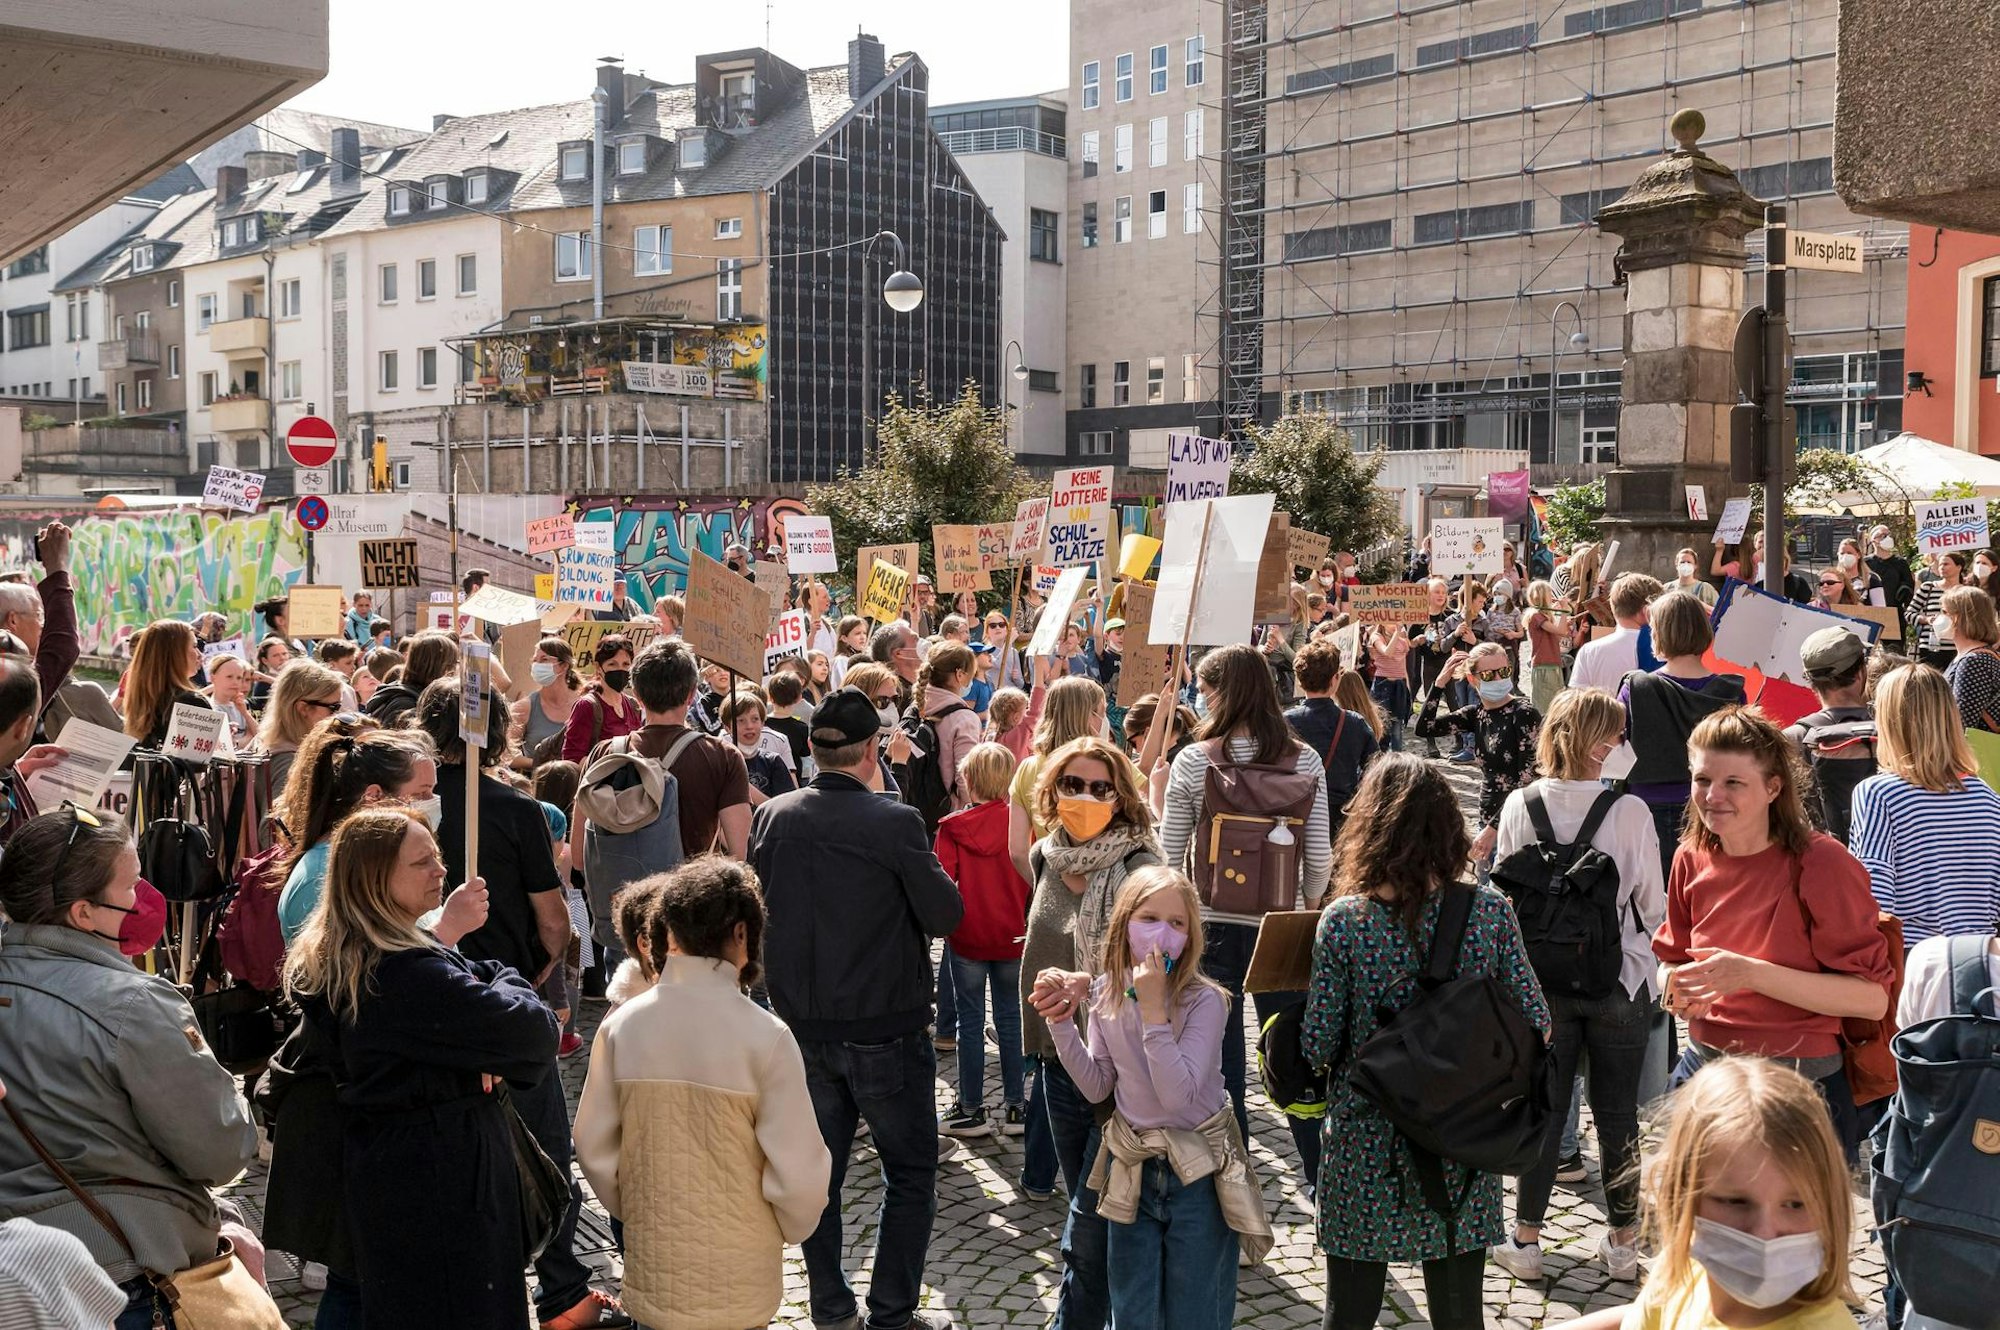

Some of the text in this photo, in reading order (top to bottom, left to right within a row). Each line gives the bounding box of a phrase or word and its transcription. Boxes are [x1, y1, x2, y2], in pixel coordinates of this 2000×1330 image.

[1794, 236, 1857, 263] Marsplatz
[686, 375, 707, 386] 100
[1171, 435, 1230, 465] LASST UNS
[1071, 470, 1102, 487] KEINE
[1053, 487, 1108, 507] LOTTERIE
[1069, 507, 1091, 523] UM
[1926, 504, 1975, 520] ALLEIN
[338, 520, 388, 533] Museum
[530, 518, 568, 532] MEHR
[1434, 525, 1470, 538] Bildung
[789, 542, 833, 553] THAT'S GOOD!
[1930, 531, 1977, 548] NEIN!
[363, 542, 417, 565] NICHT
[893, 548, 908, 568] BIN
[1054, 540, 1105, 561] PLÄTZE
[1452, 550, 1466, 559] Los
[363, 566, 420, 587] LOSEN
[870, 565, 905, 600] MEHR
[1352, 583, 1429, 596] WIR MÖCHTEN
[1353, 599, 1430, 609] ZUSAMMEN ZUR
[1358, 611, 1401, 622] SCHULE
